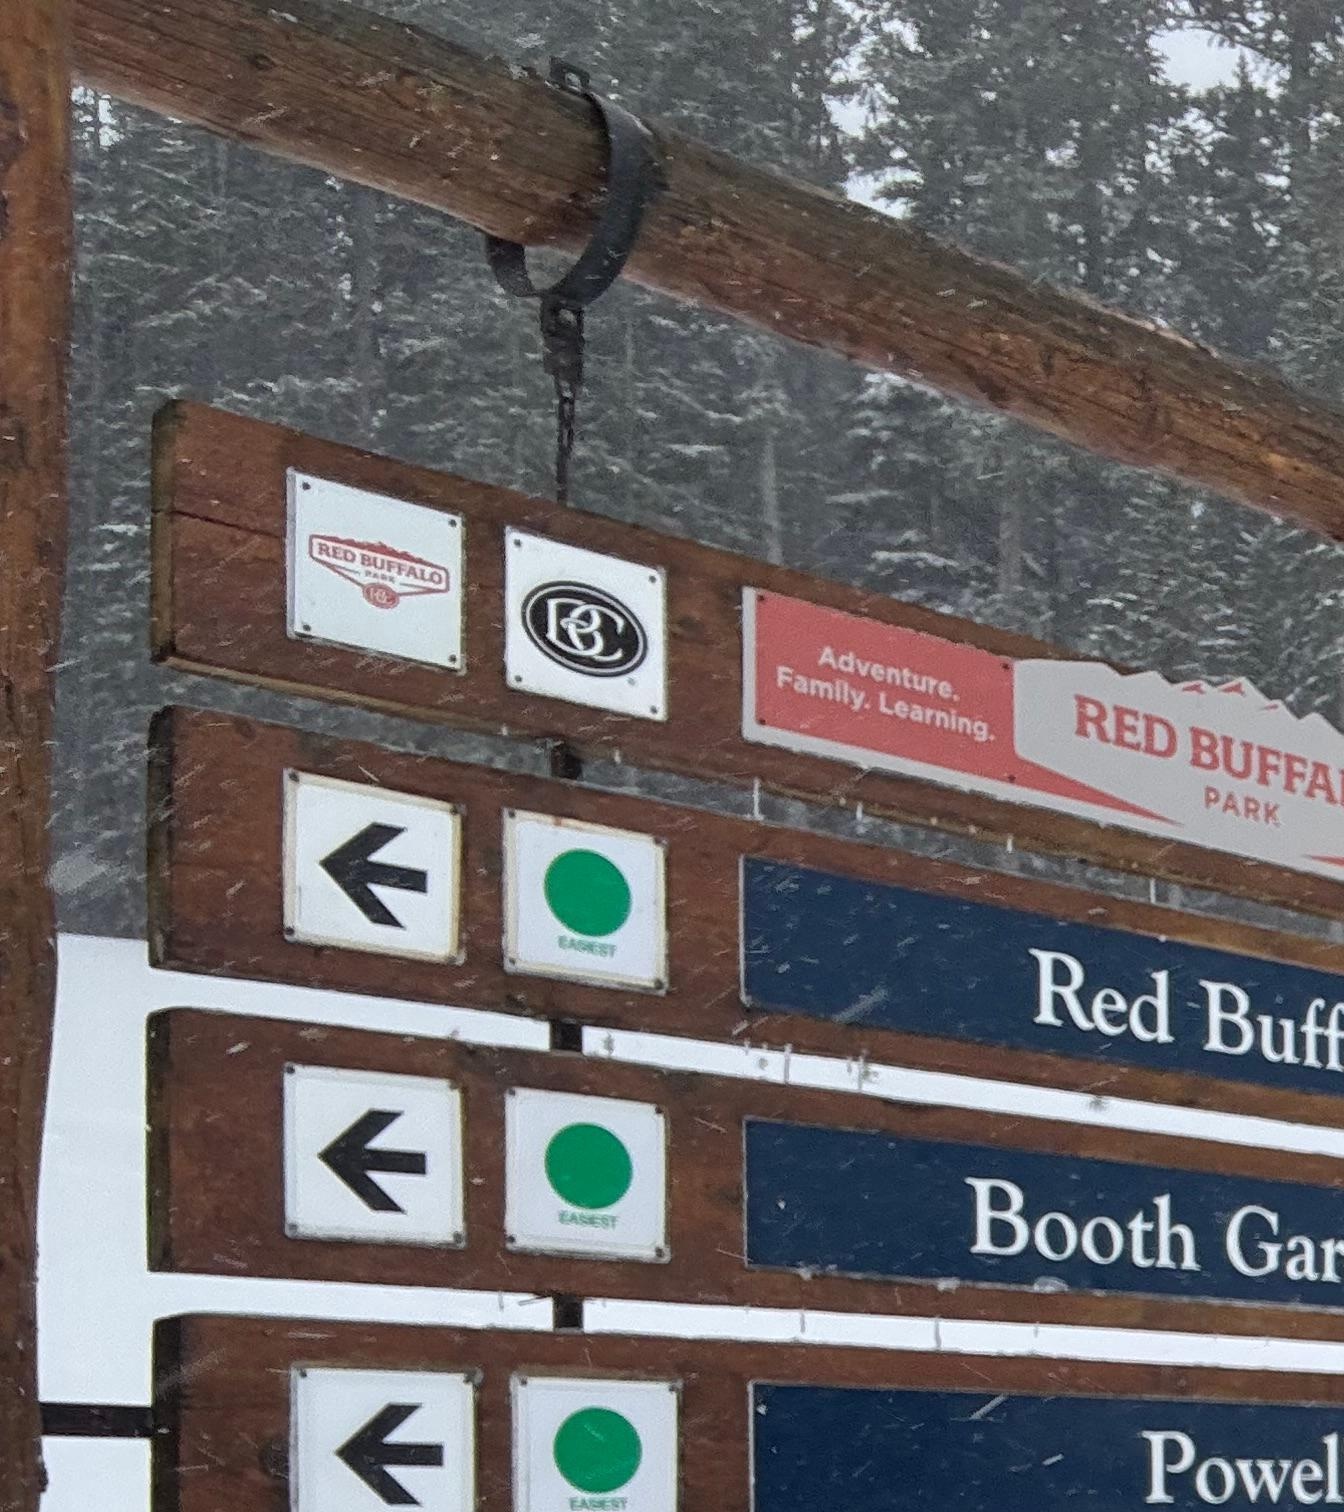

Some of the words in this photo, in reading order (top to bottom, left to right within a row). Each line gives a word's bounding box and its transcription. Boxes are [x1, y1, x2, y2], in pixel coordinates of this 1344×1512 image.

[317, 542, 356, 564] RED
[360, 553, 443, 586] BUFFALO
[364, 569, 396, 584] PARK
[817, 646, 961, 702] Adventure.
[776, 666, 872, 712] Family.
[879, 692, 996, 743] Learning.
[1073, 693, 1179, 760] RED
[1204, 786, 1282, 828] PARK
[1028, 947, 1176, 1045] Red
[558, 1209, 618, 1231] EASIEST
[964, 1175, 1203, 1272] Booth
[567, 1496, 628, 1512] EASIEST
